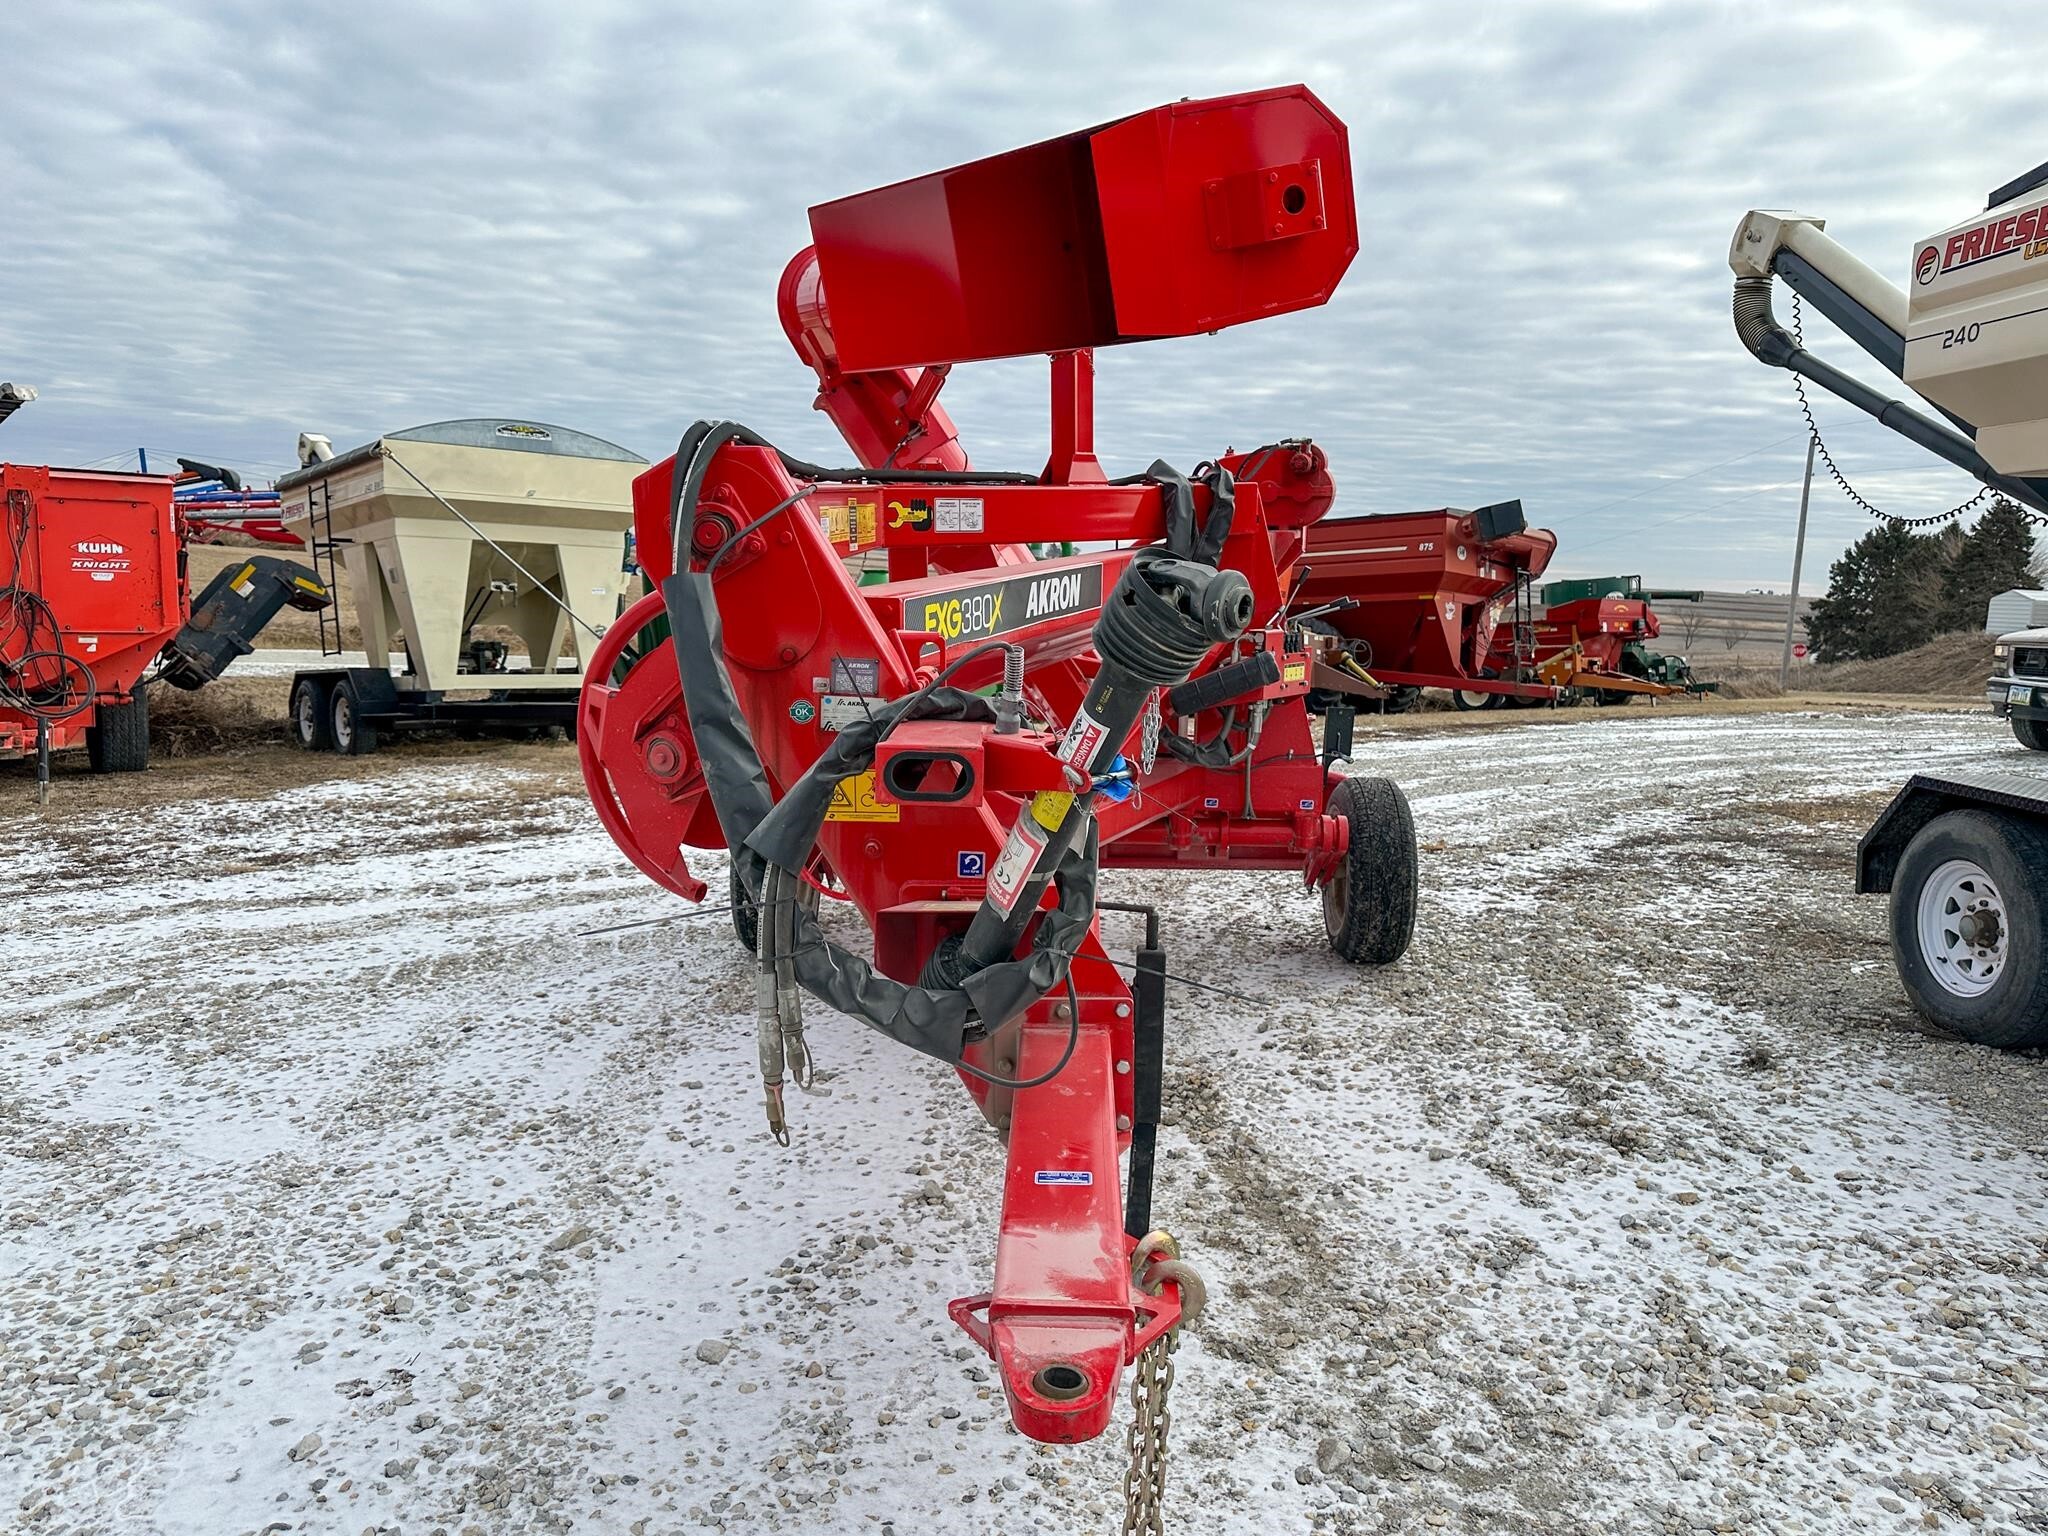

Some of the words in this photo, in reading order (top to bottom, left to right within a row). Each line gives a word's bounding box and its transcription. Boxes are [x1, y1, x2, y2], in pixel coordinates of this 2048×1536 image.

[2023, 239, 2048, 261] US
[1942, 322, 1980, 350] 240
[78, 542, 123, 553] KUHN
[1418, 542, 1434, 551] 875
[72, 561, 130, 569] KNIGHT
[1025, 573, 1082, 619] AKRON
[795, 708, 810, 716] OK
[1073, 738, 1093, 768] DANGER
